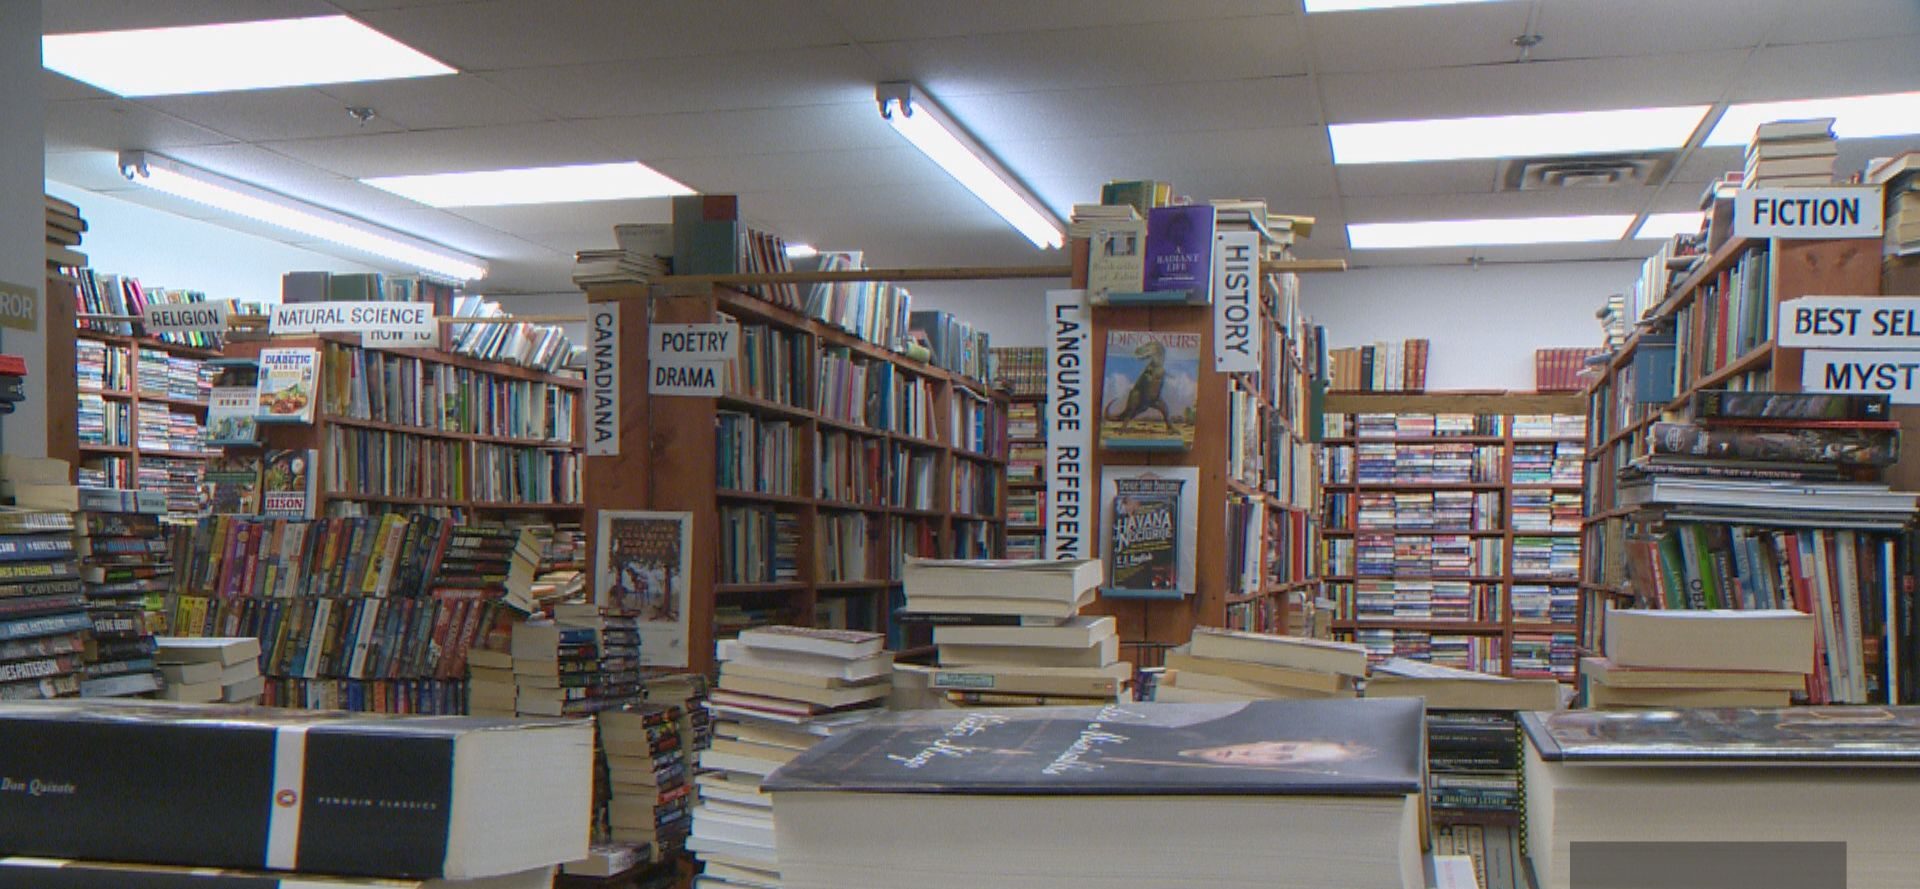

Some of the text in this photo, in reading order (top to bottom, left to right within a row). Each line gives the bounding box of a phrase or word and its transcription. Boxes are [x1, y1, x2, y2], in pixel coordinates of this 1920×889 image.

[1753, 197, 1860, 226] FICTION
[1156, 253, 1200, 265] RADIANT
[1166, 263, 1187, 272] LIFE
[0, 291, 33, 319] ROR
[1224, 245, 1249, 355] HISTORY
[151, 309, 219, 327] RELIGION
[277, 307, 425, 326] NATURAL SCIENCE
[1794, 308, 1920, 336] BEST SEL
[661, 331, 729, 353] POETRY
[264, 355, 311, 364] DIABETIC
[1055, 304, 1080, 431] LANGUAGE
[594, 312, 613, 443] CANADIANA
[655, 366, 716, 388] DRAMA
[1824, 363, 1920, 391] MYST
[266, 499, 305, 509] BISON
[1117, 510, 1173, 534] HAVANA
[95, 620, 114, 632] STEVE
[16, 658, 59, 680] PATTERSON
[1, 777, 76, 797] Don Quixote
[318, 796, 437, 810] PENGUIN CLASSICS
